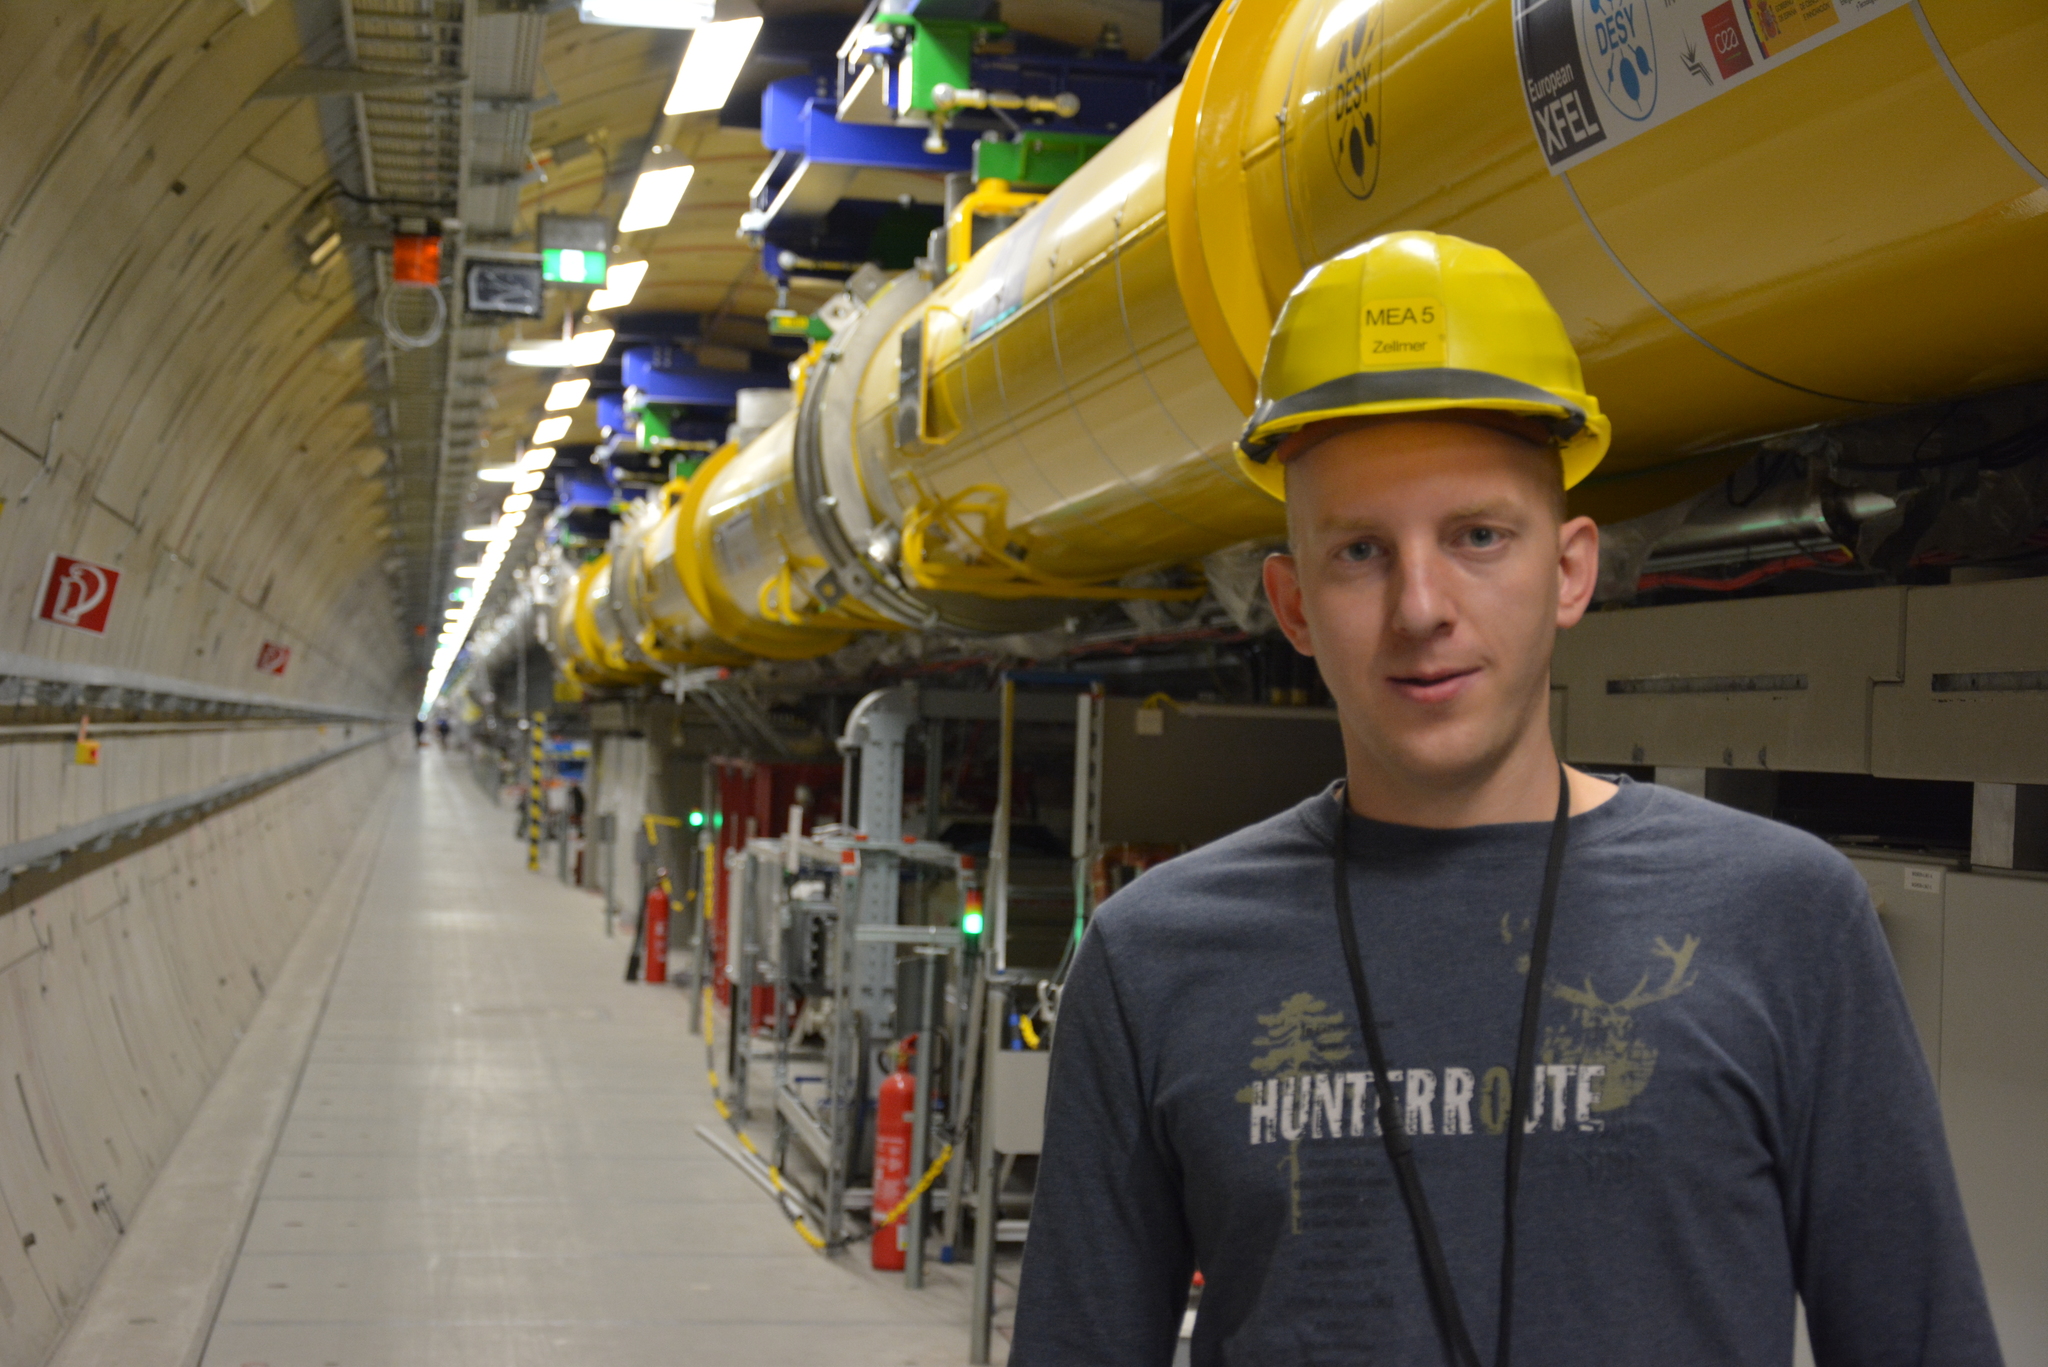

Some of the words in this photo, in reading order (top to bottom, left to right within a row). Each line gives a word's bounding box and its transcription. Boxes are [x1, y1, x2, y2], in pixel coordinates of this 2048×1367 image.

[1595, 4, 1635, 56] DESY
[1715, 27, 1739, 54] cea
[1336, 62, 1371, 121] DESY
[1527, 63, 1574, 103] European
[1535, 89, 1599, 156] XFEL
[1365, 307, 1417, 326] MEA
[1422, 306, 1435, 324] 5
[1372, 340, 1427, 354] Zellmer
